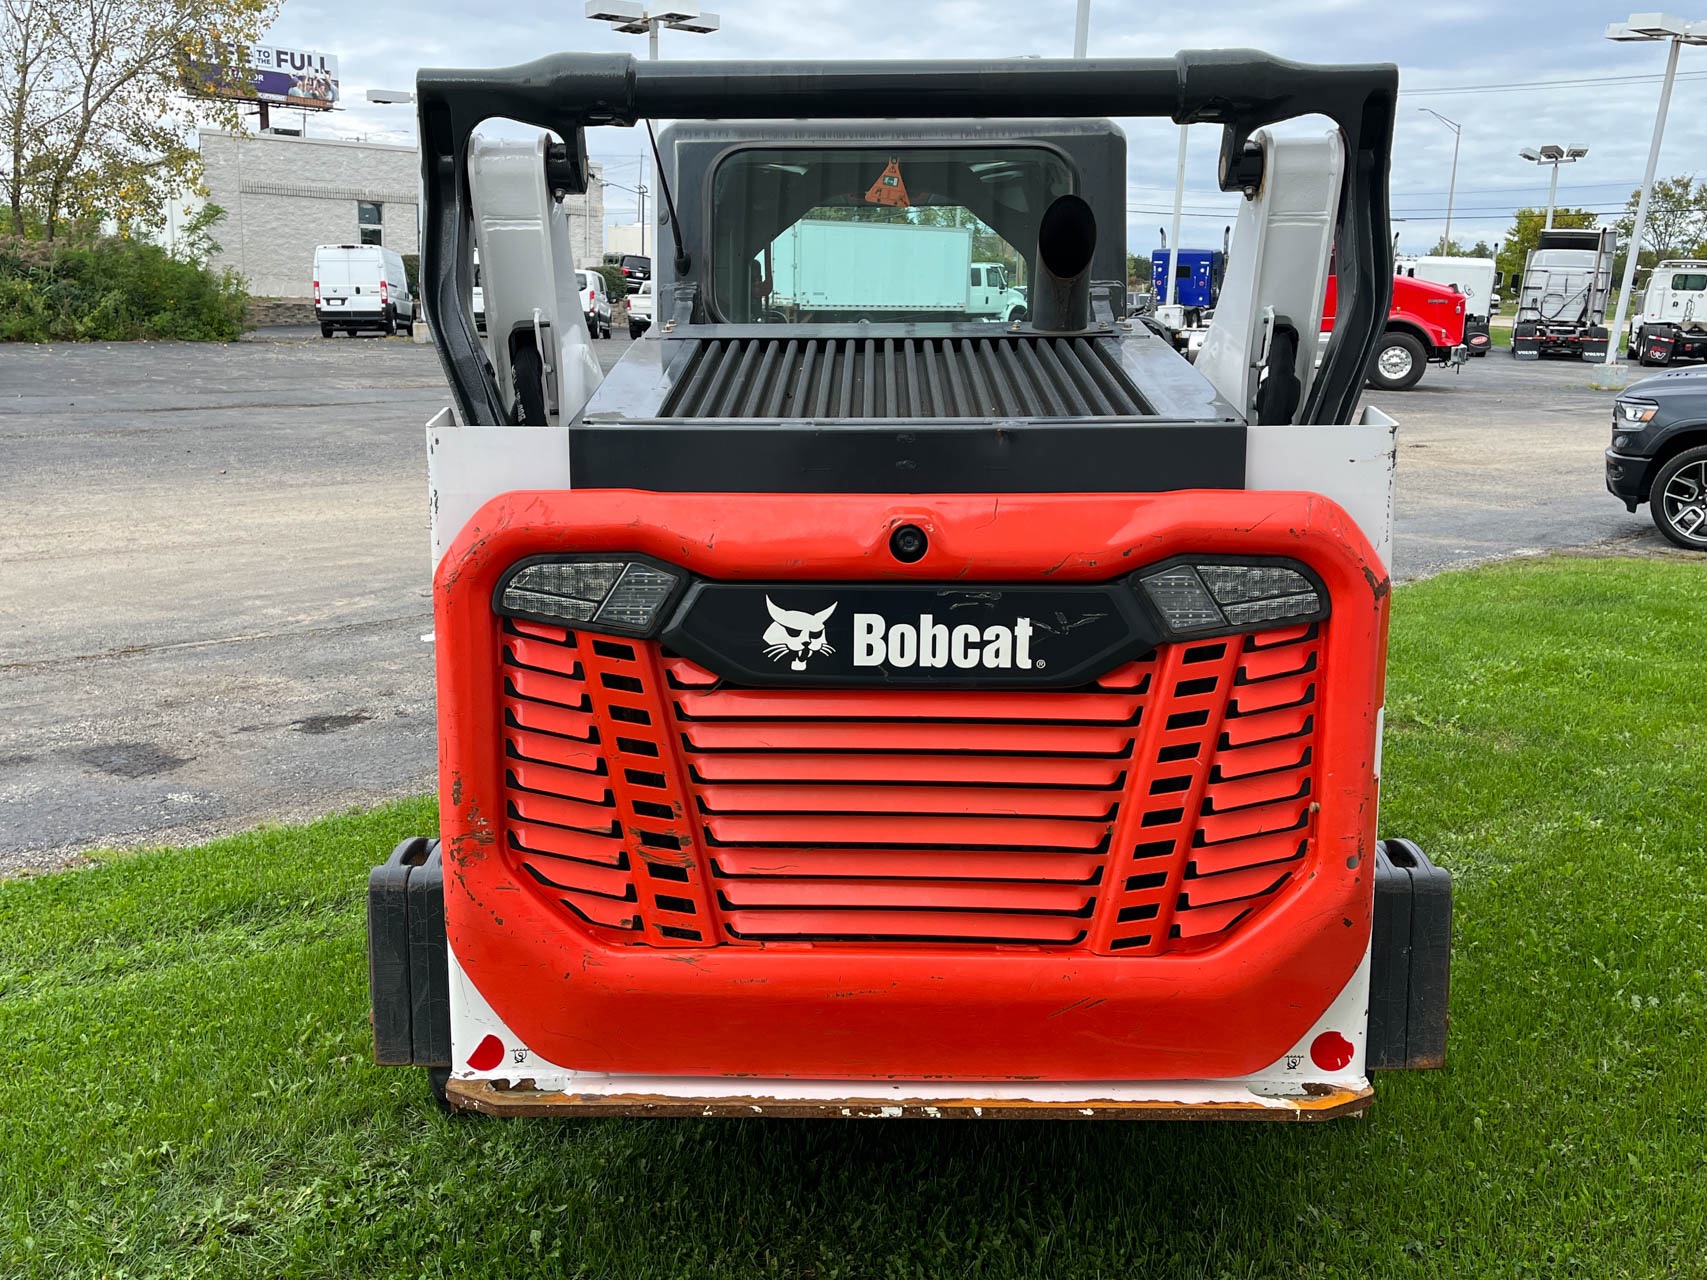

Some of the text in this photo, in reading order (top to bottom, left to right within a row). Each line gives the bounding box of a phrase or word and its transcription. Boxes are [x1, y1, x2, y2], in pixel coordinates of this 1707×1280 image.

[256, 49, 271, 58] TO
[276, 50, 331, 75] FULL
[853, 613, 1034, 670] Bobcat
